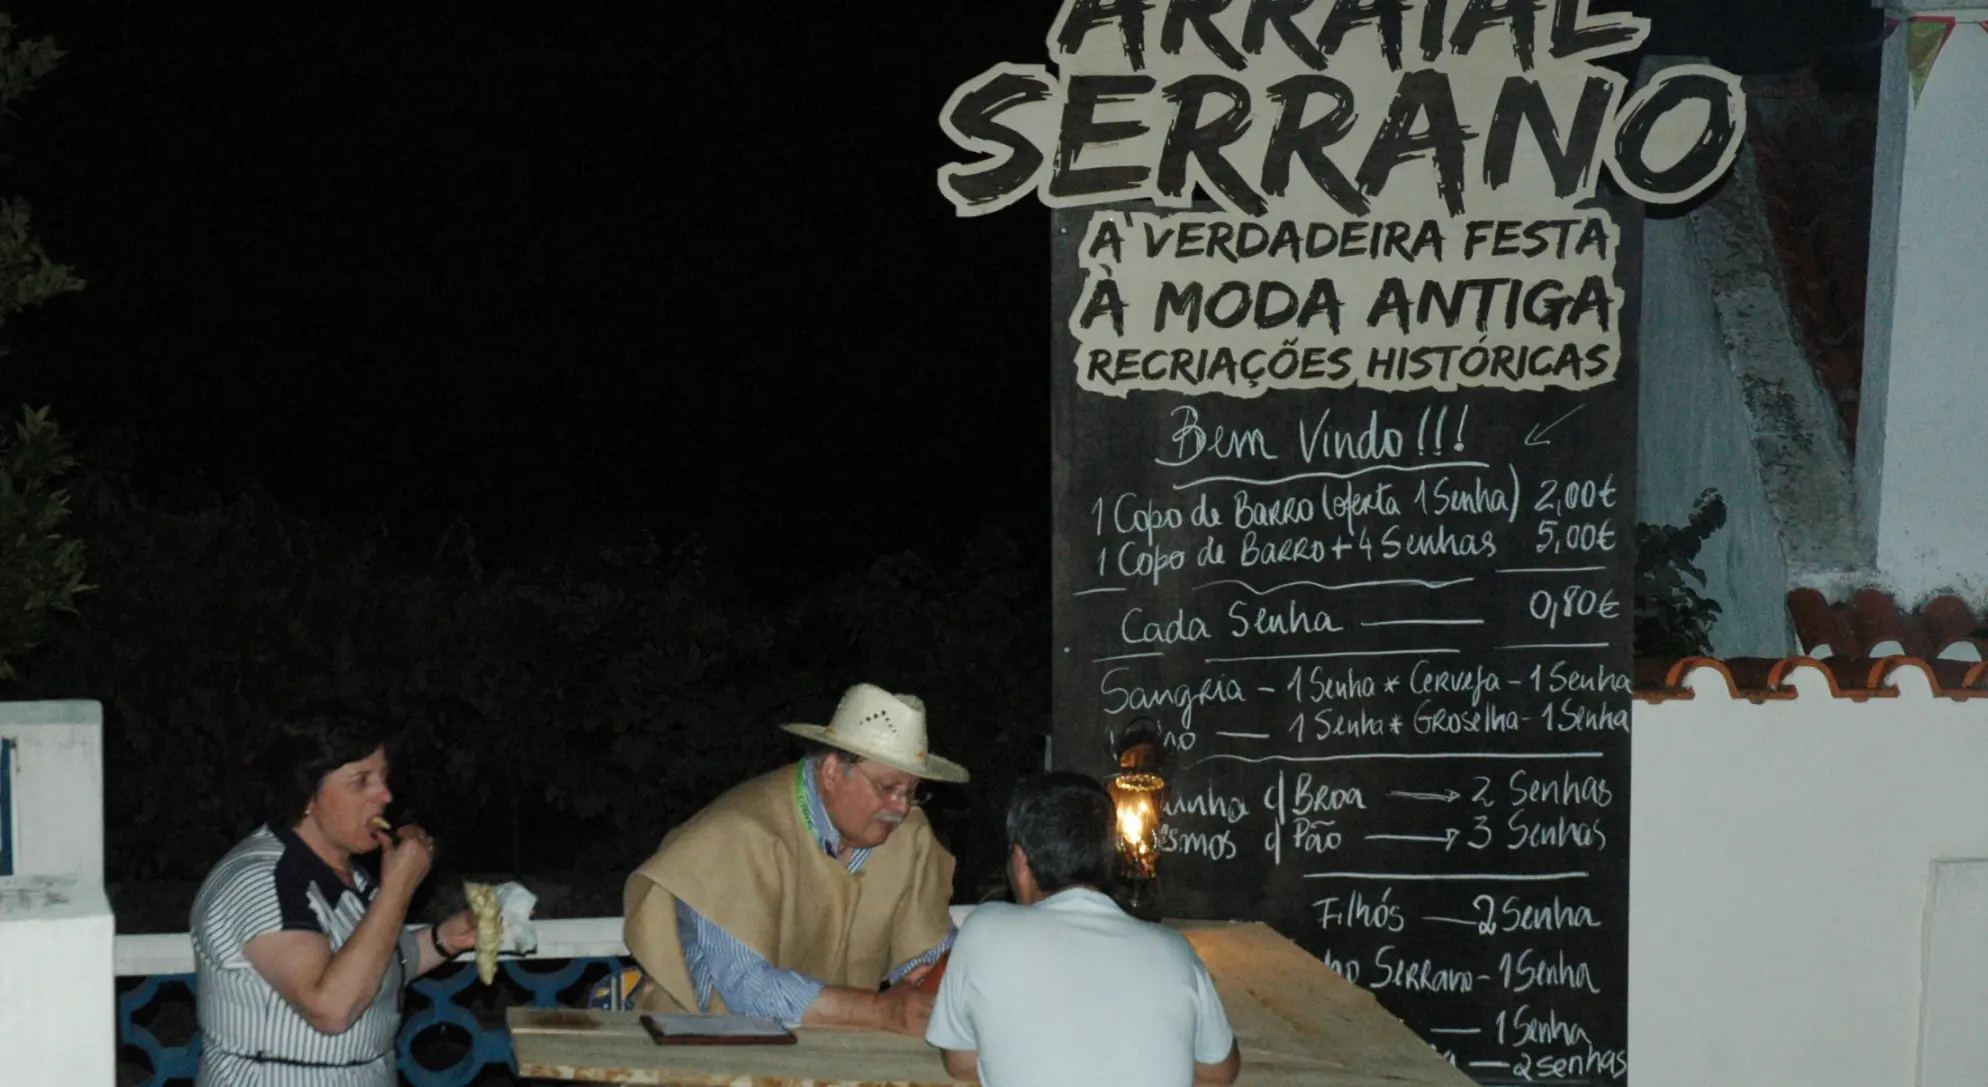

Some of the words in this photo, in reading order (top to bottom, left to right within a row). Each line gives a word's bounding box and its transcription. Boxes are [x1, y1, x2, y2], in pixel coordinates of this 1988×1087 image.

[948, 68, 1733, 218] SERRANO
[1143, 221, 1446, 264] VERDADEIRA
[1465, 218, 1610, 263] FESTA
[1079, 263, 1129, 337] À
[1154, 279, 1348, 336] MODA
[1366, 276, 1620, 336] ANTIGA
[1086, 337, 1351, 389] RECRIAÇÕES
[1367, 336, 1611, 382] HISTÓRICAS
[1154, 404, 1278, 466] Bem
[1114, 492, 1183, 547] Copo
[1190, 492, 1223, 528] de
[1534, 473, 1617, 516] 2,00€
[1118, 541, 1186, 587] Copo
[1197, 535, 1226, 567] de
[1381, 524, 1497, 560] Senhas
[1536, 518, 1616, 554] 5,00€
[1121, 607, 1212, 646] Cada
[1228, 600, 1344, 637] Senha
[1529, 585, 1621, 629] 0,80€
[1471, 776, 1495, 808] 2
[1508, 769, 1613, 807] Senhas
[1292, 818, 1342, 854] Pão
[1467, 815, 1493, 849] 3
[1507, 808, 1606, 850] Senhas
[1312, 887, 1405, 932] Filhós
[1502, 896, 1603, 932] Senha
